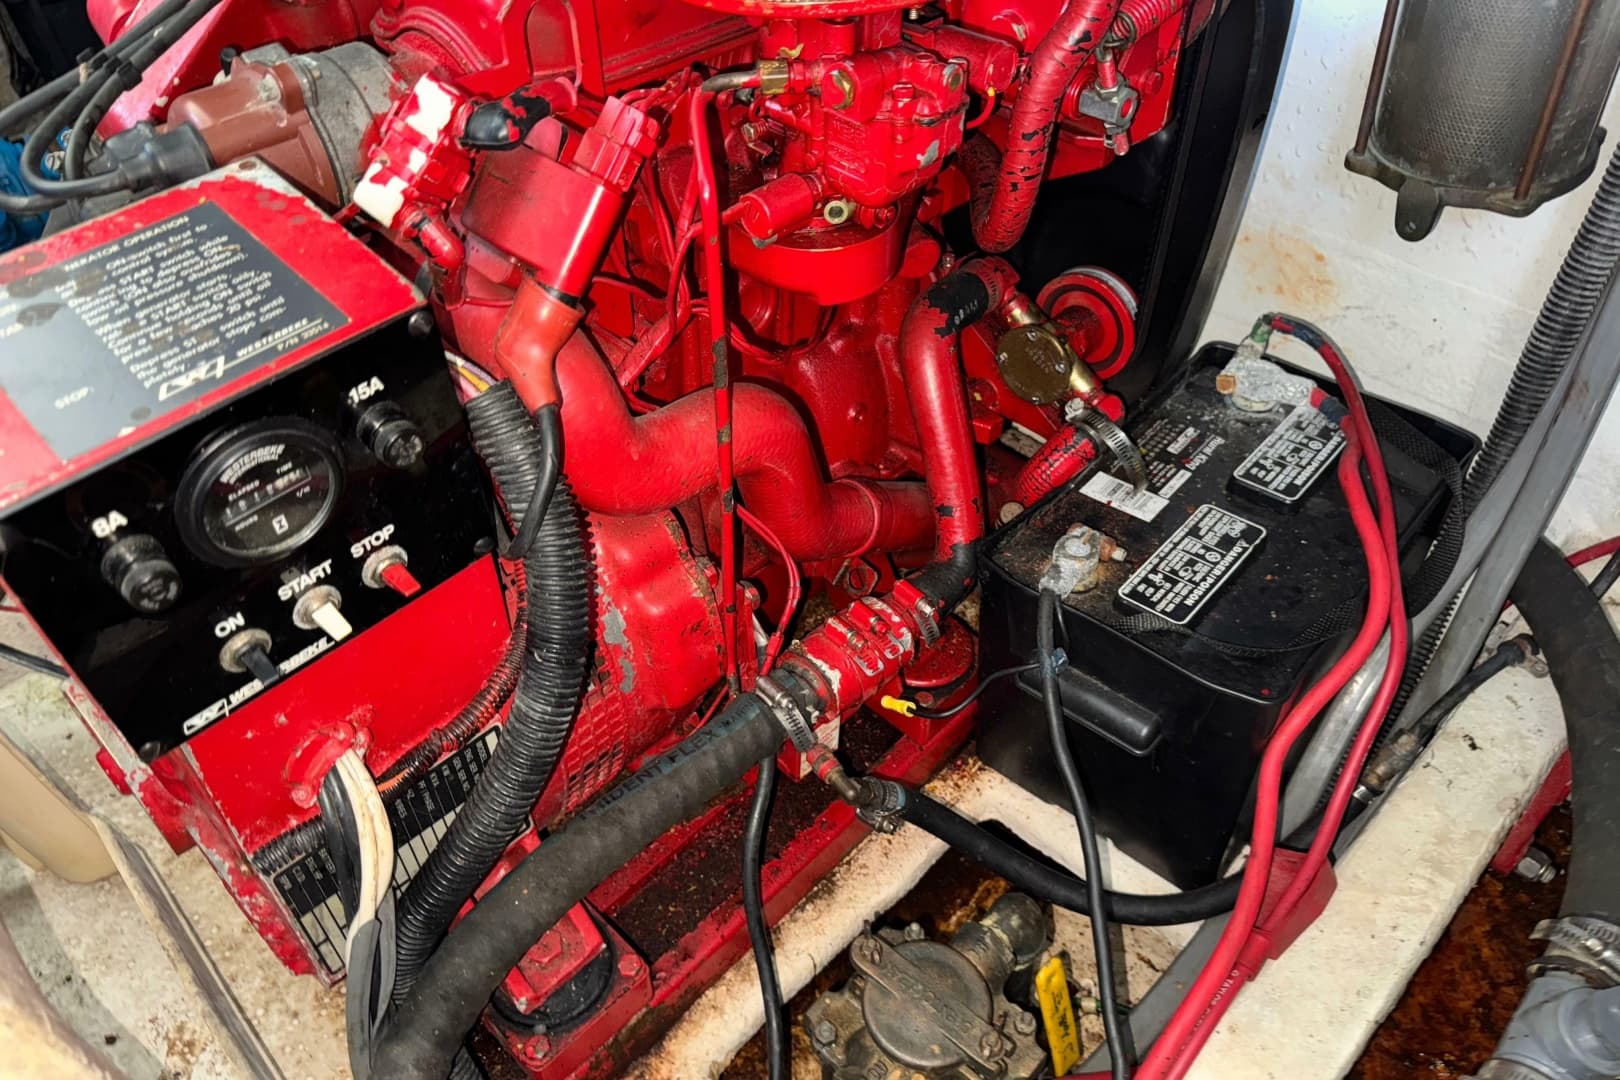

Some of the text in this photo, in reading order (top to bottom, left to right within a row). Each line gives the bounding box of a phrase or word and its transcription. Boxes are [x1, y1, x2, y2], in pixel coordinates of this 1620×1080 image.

[123, 214, 189, 248] OPERATION
[167, 229, 191, 244] first
[194, 223, 207, 233] to
[118, 264, 154, 286] START
[159, 248, 194, 268] switch
[198, 233, 228, 252] while
[139, 275, 152, 286] to
[156, 254, 200, 279] depress
[151, 273, 176, 290] also
[151, 299, 187, 320] START
[192, 281, 227, 302] switch
[87, 312, 108, 327] low
[114, 303, 129, 315] oil
[134, 279, 183, 306] pressure
[95, 314, 129, 336] When
[135, 288, 190, 319] generator
[107, 270, 271, 350] Continue holding ON switch
[113, 343, 131, 356] for
[150, 324, 172, 340] few
[227, 288, 252, 304] until
[255, 279, 271, 291] oil
[226, 302, 241, 314] 20
[130, 345, 179, 374] Depress
[218, 309, 254, 331] switch
[259, 295, 284, 313] until
[137, 366, 157, 379] the
[162, 336, 221, 369] generator
[226, 319, 256, 340] stops
[235, 317, 310, 357] WESTERBEKE
[351, 377, 384, 405] 15A
[220, 444, 285, 483] WESTERBEKE
[228, 461, 292, 501] ELAPSED TIME
[91, 510, 128, 539] 8A
[350, 525, 395, 559] STOP
[278, 559, 333, 601] START
[1184, 545, 1243, 606] DANGER/POISON
[214, 613, 245, 639] ON
[667, 729, 720, 763] FLEX
